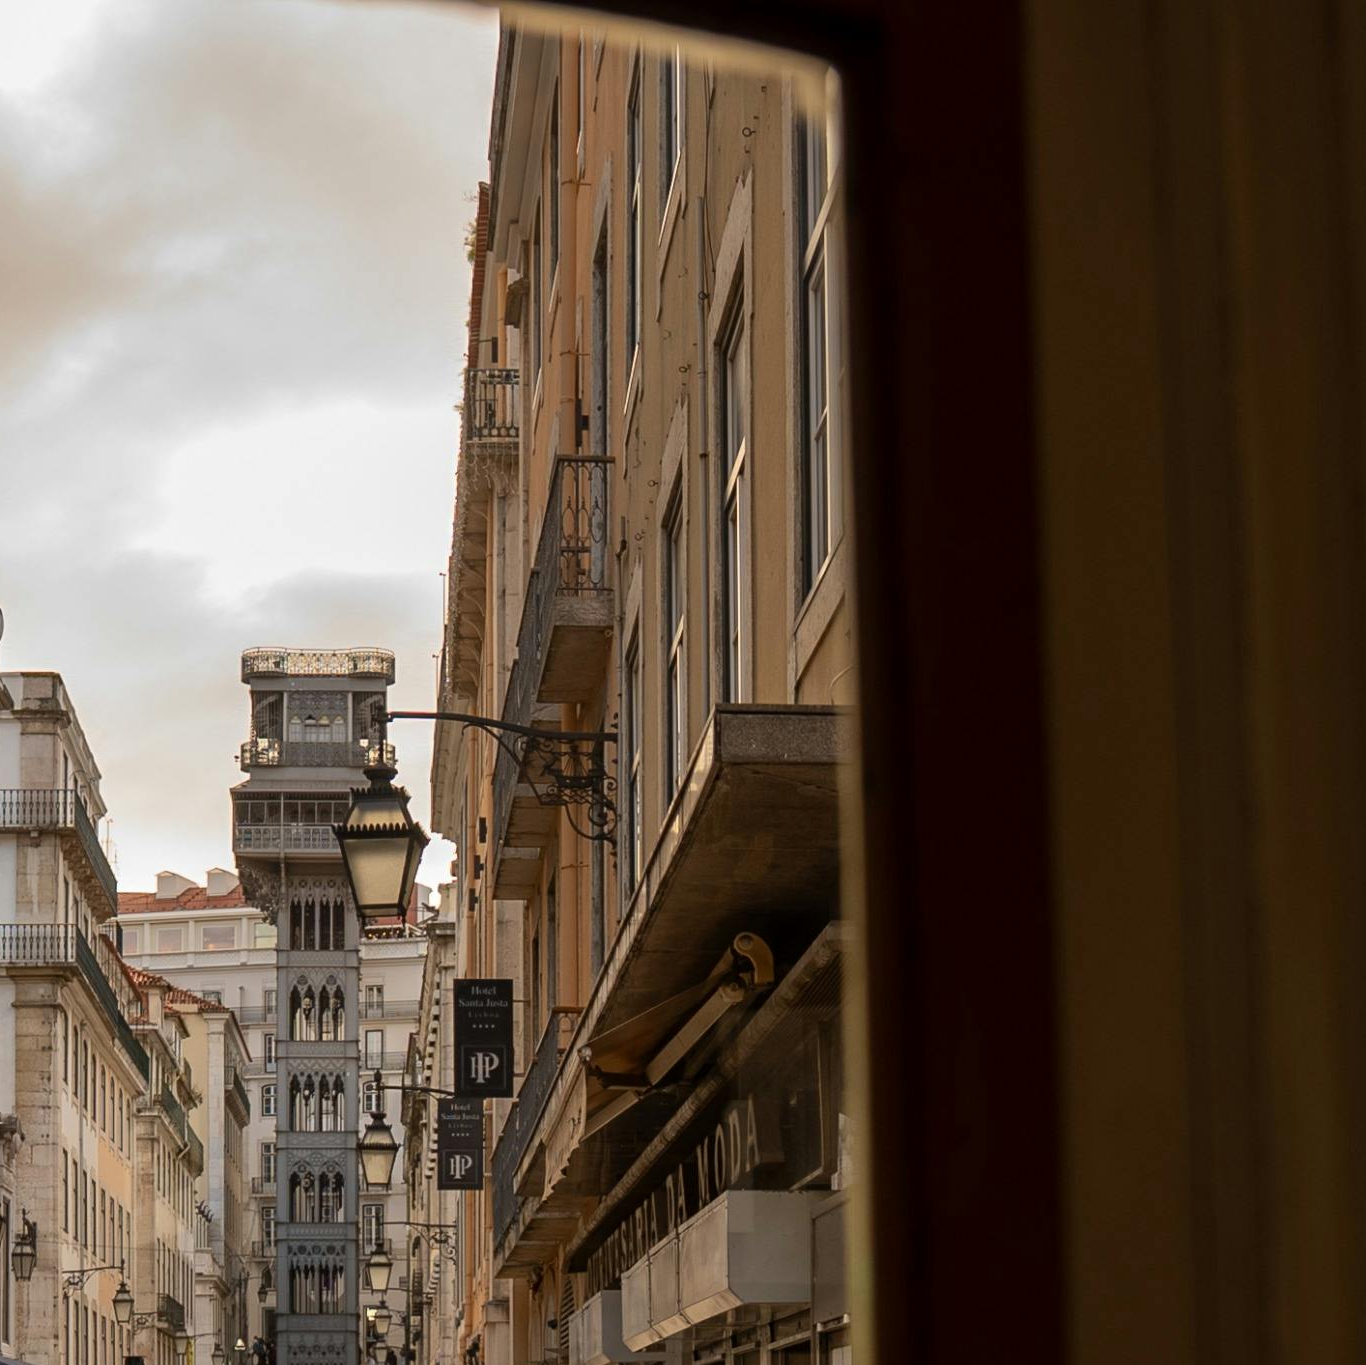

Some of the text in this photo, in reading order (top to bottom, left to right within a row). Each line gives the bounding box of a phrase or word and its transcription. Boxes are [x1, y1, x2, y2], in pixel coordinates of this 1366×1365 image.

[471, 985, 496, 996] Hotel
[458, 998, 509, 1008] Santa Justa
[696, 1093, 760, 1211] MODA
